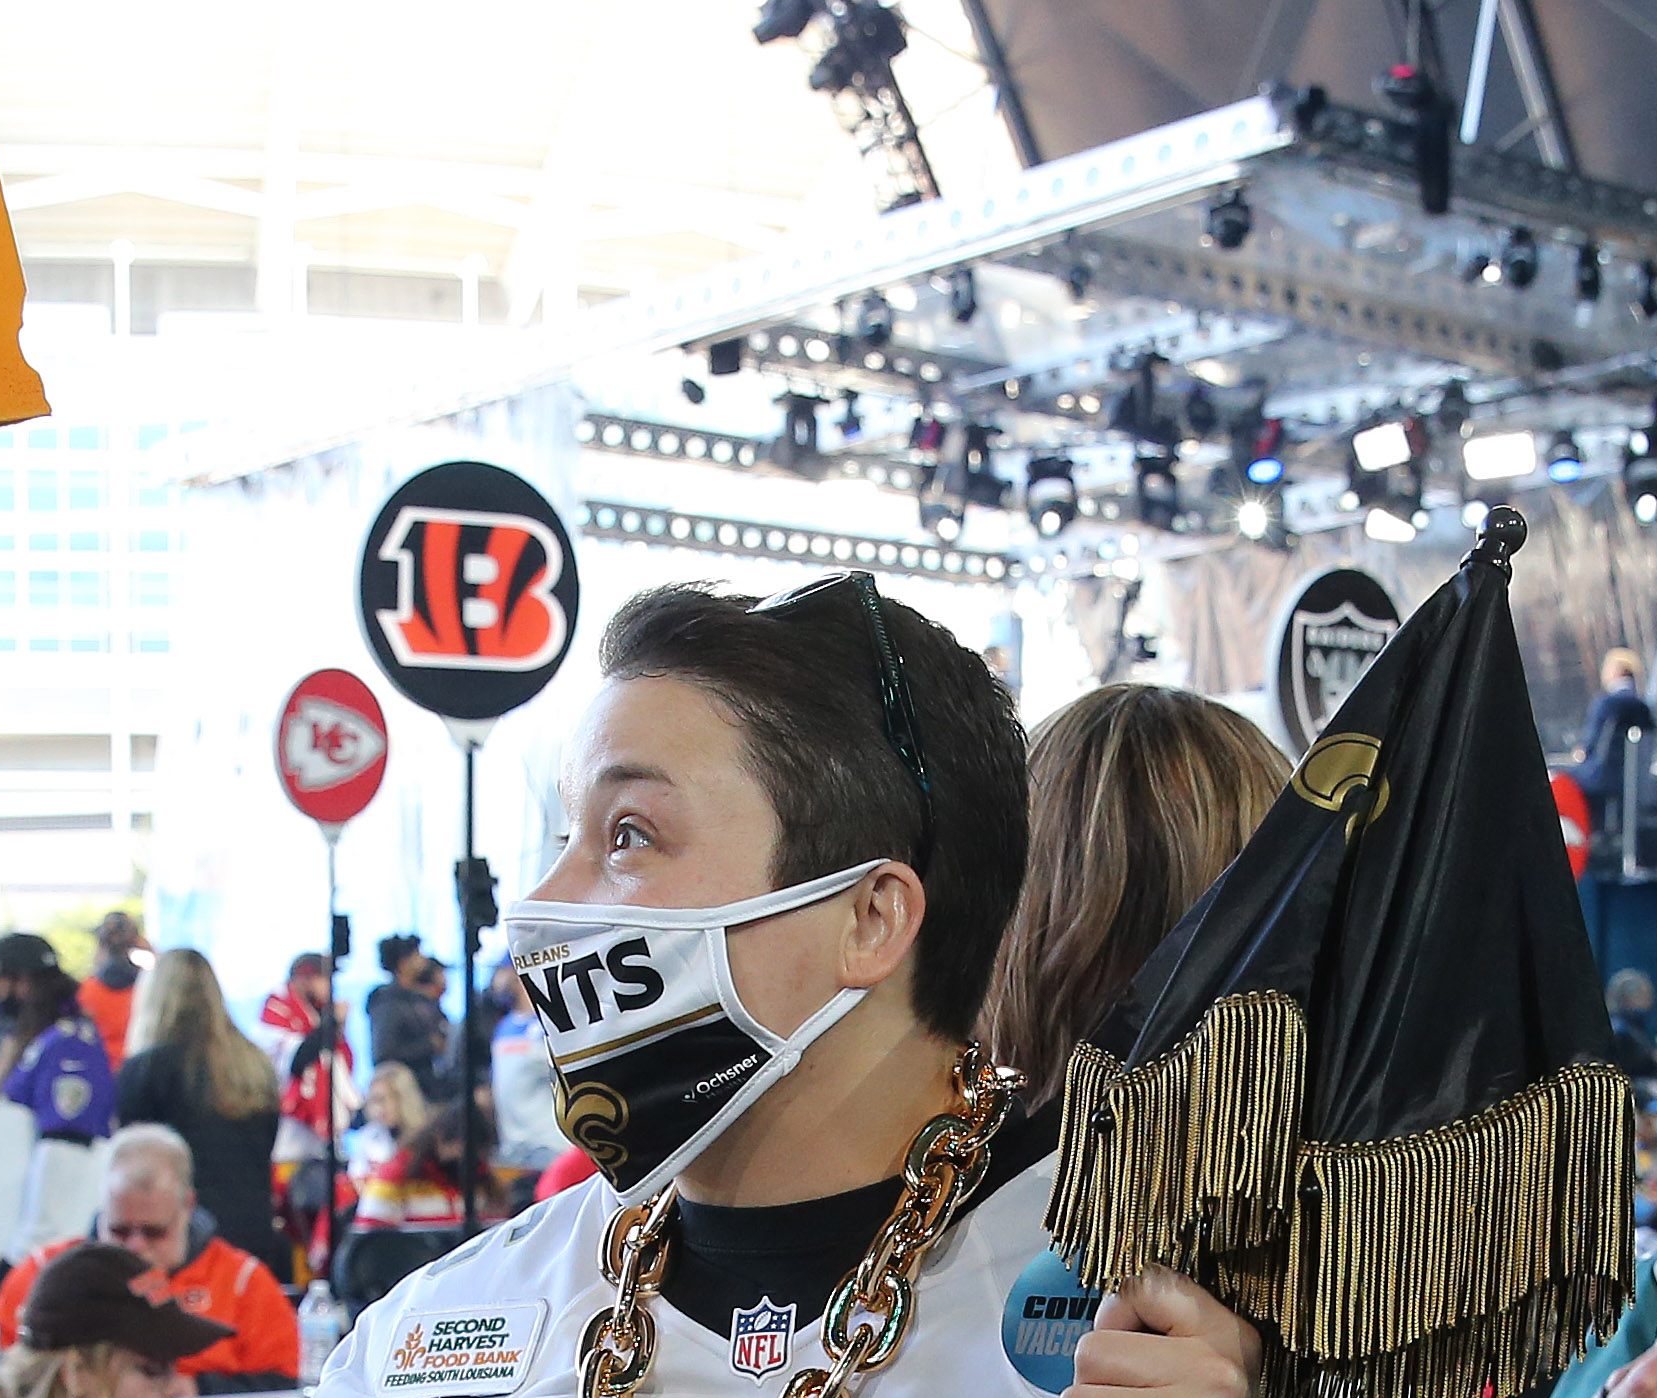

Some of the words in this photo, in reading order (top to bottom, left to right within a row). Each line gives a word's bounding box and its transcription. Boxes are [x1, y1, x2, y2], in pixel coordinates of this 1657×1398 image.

[375, 505, 568, 672] B
[695, 1052, 759, 1096] Ochsner
[432, 1316, 507, 1337] SECOND
[426, 1332, 511, 1354] HARVEST
[737, 1333, 784, 1370] NFL
[422, 1352, 470, 1370] FOOD
[473, 1349, 523, 1367] BANK
[383, 1372, 427, 1388] FEEDING
[427, 1369, 460, 1385] SOUTH
[459, 1365, 515, 1381] LOUISIANA
